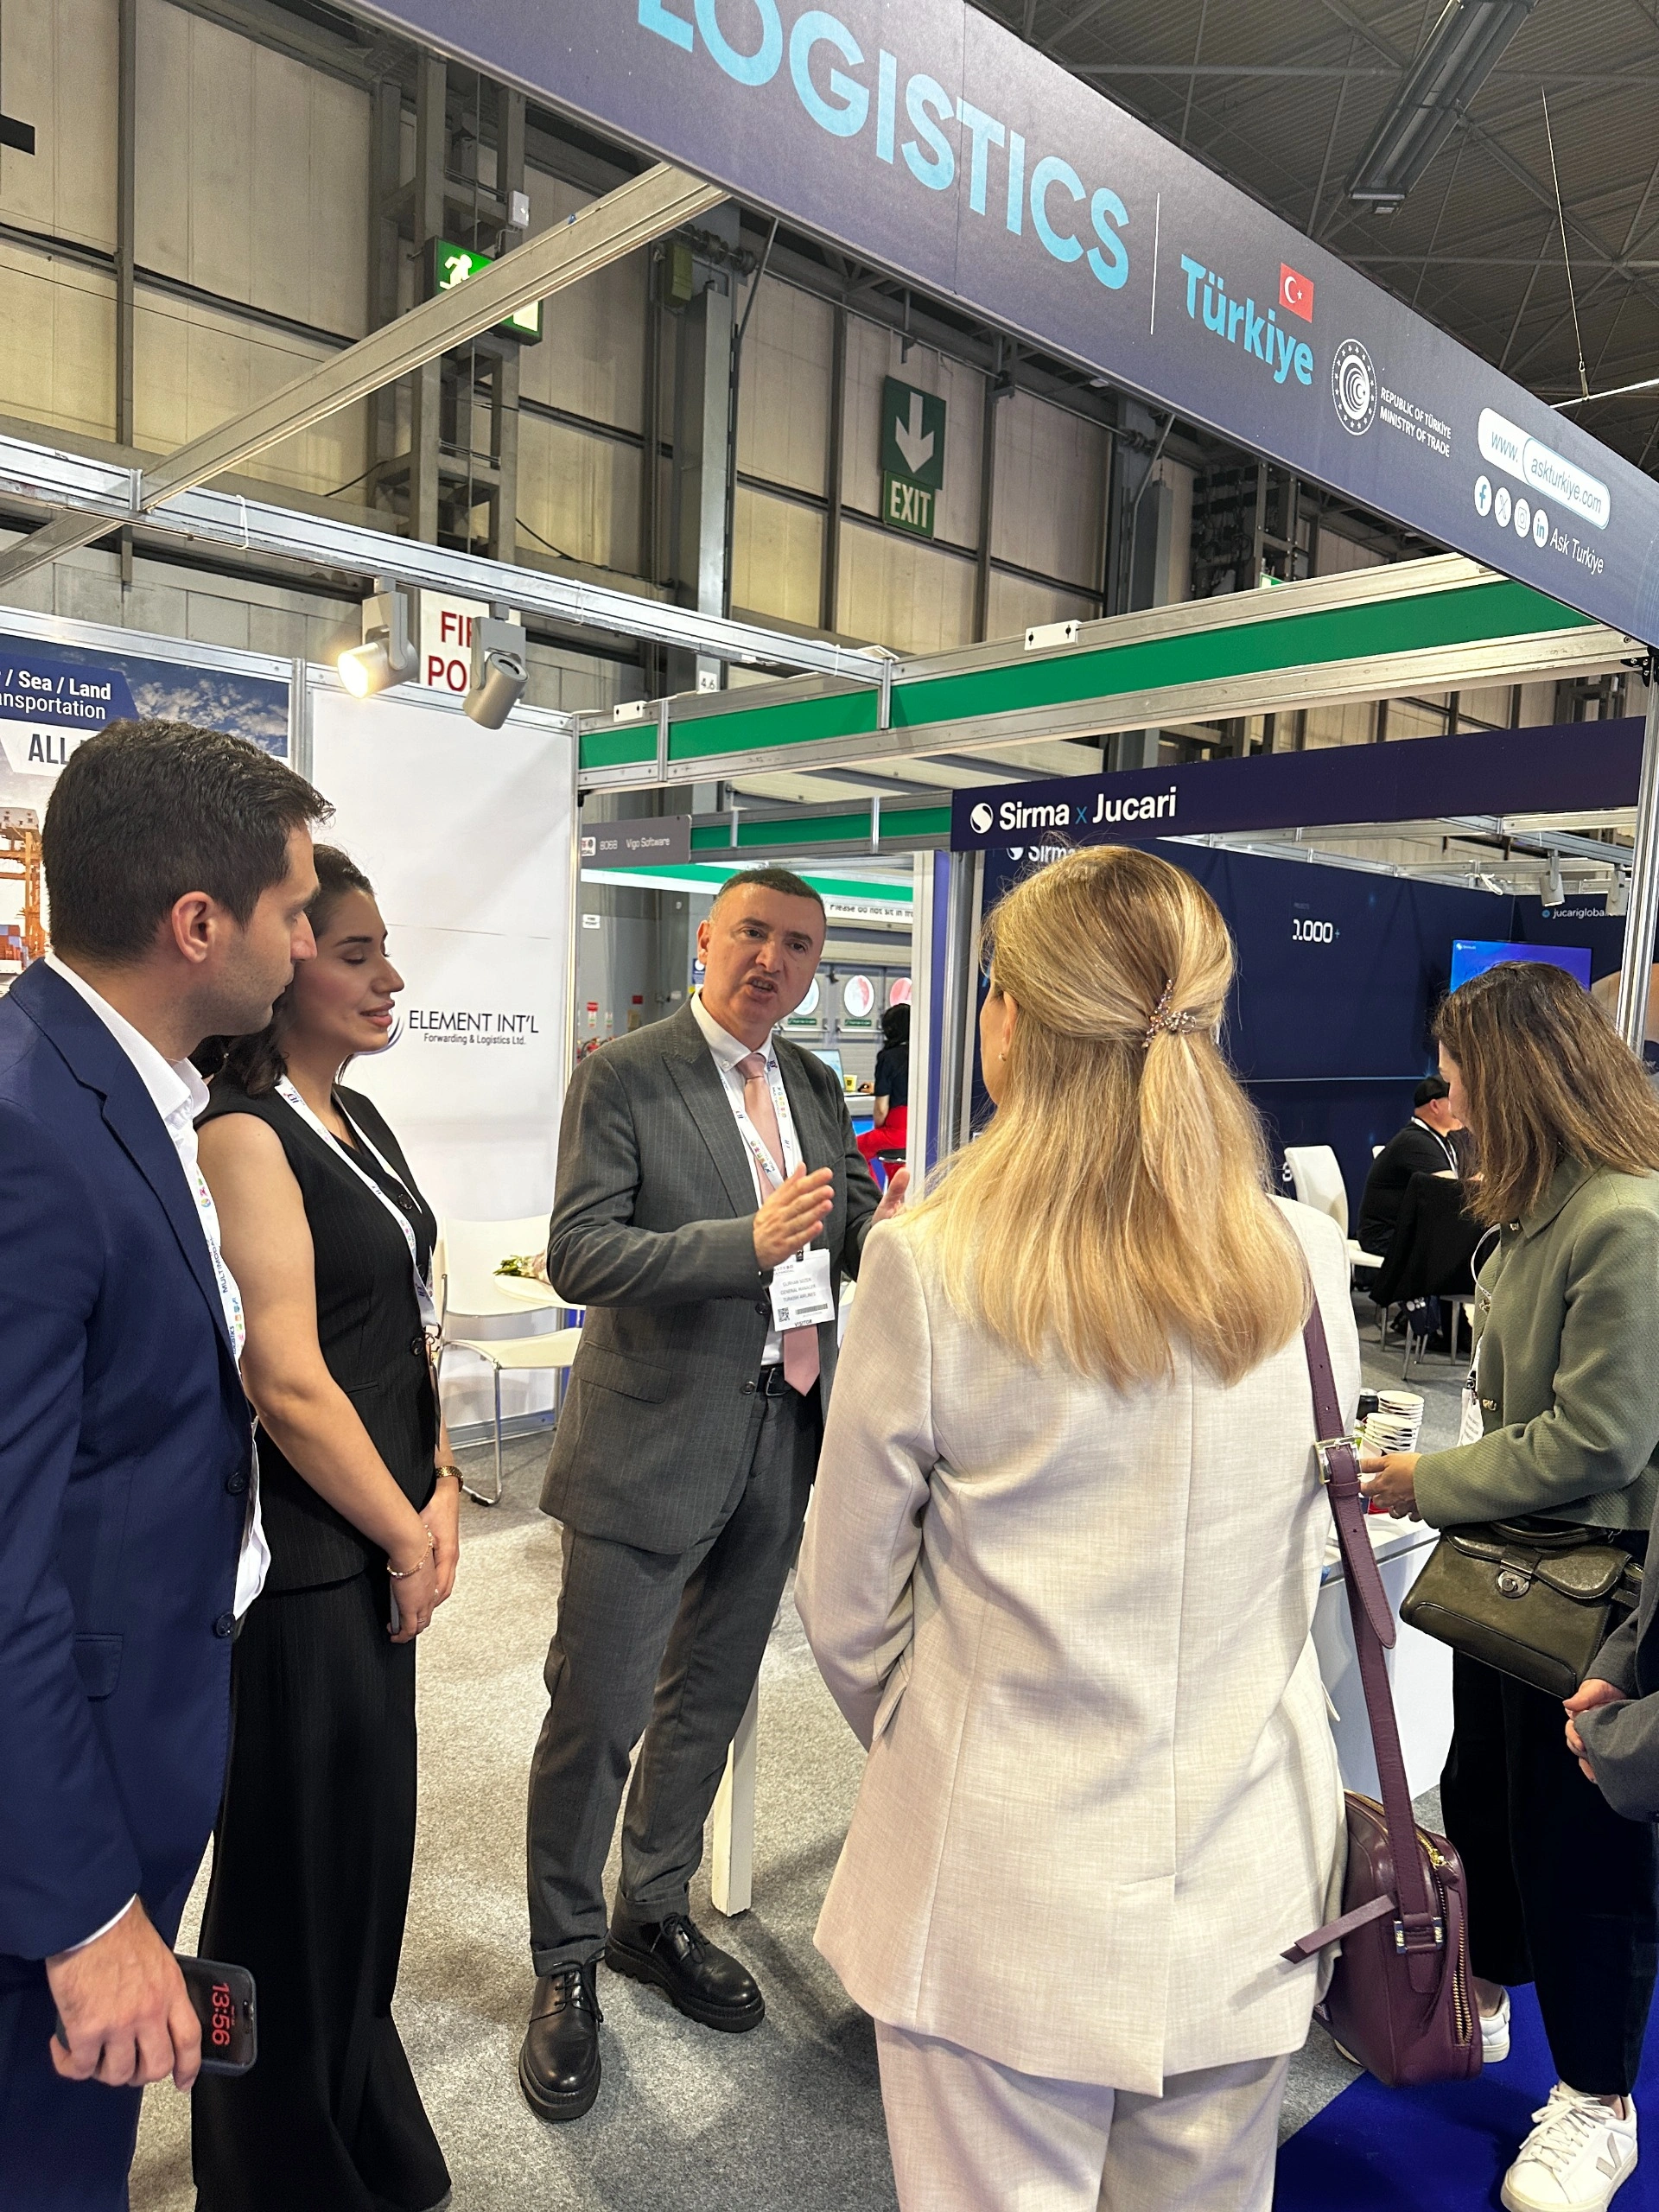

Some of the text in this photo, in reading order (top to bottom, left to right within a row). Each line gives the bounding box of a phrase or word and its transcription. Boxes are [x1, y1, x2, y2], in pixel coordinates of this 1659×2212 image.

[1180, 253, 1313, 385] Türkiye
[1380, 405, 1450, 457] MINISTRY OF TRADE
[1381, 386, 1451, 440] REPUBLIC OF TÜRKİYE
[1491, 431, 1602, 514] www. askturkiye.com
[890, 480, 931, 529] EXIT
[1550, 528, 1570, 556] Ask
[1572, 537, 1604, 575] Turkiye
[0, 692, 105, 720] nsportation
[18, 671, 53, 692] Sea
[69, 677, 111, 701] Land
[28, 734, 71, 766] ALL
[999, 786, 1177, 830] Sirma x Jucari
[626, 838, 639, 850] Vigo
[641, 837, 671, 847] Software
[1552, 907, 1606, 919] jucarigloba
[409, 1010, 493, 1032] ELEMENT
[423, 1033, 526, 1046] Forwarding & Logistics Ltd.
[212, 1982, 231, 2046] 13:56
